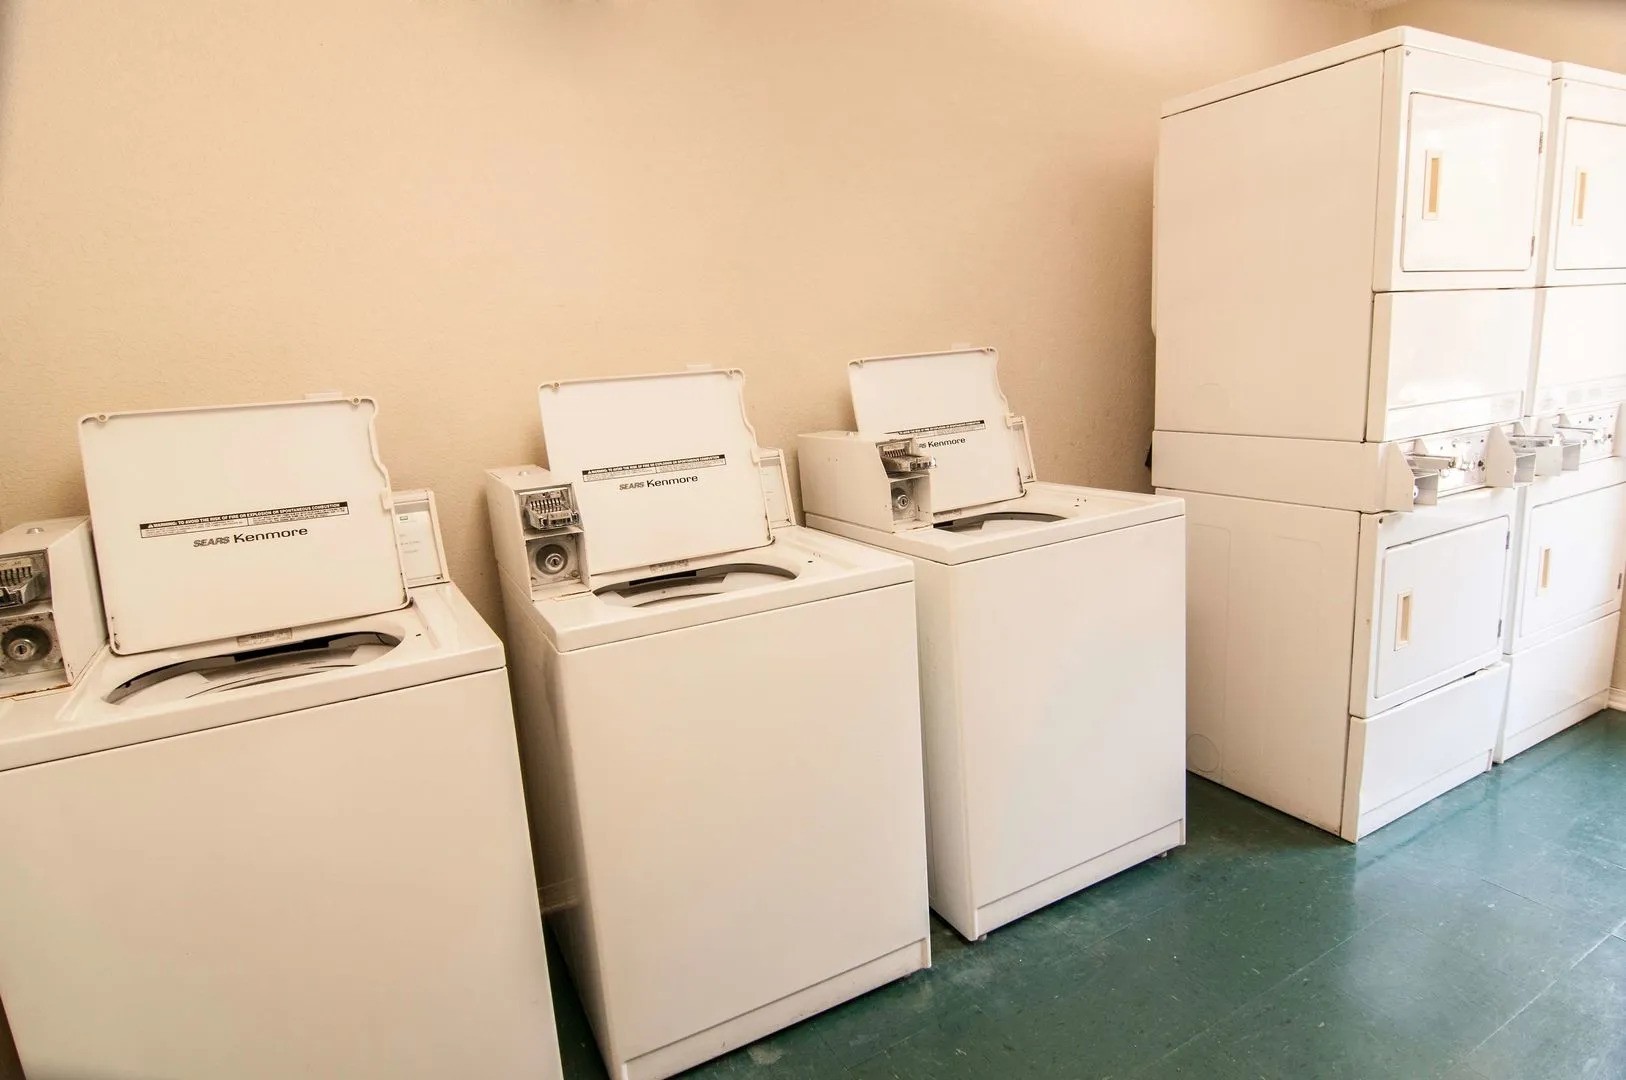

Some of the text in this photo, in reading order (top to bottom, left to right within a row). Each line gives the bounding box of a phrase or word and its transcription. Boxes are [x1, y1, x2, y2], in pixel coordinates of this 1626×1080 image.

[927, 437, 966, 448] Kenmore
[619, 475, 698, 490] SEARS Kenmore
[193, 528, 308, 548] SEARS Kenmore
